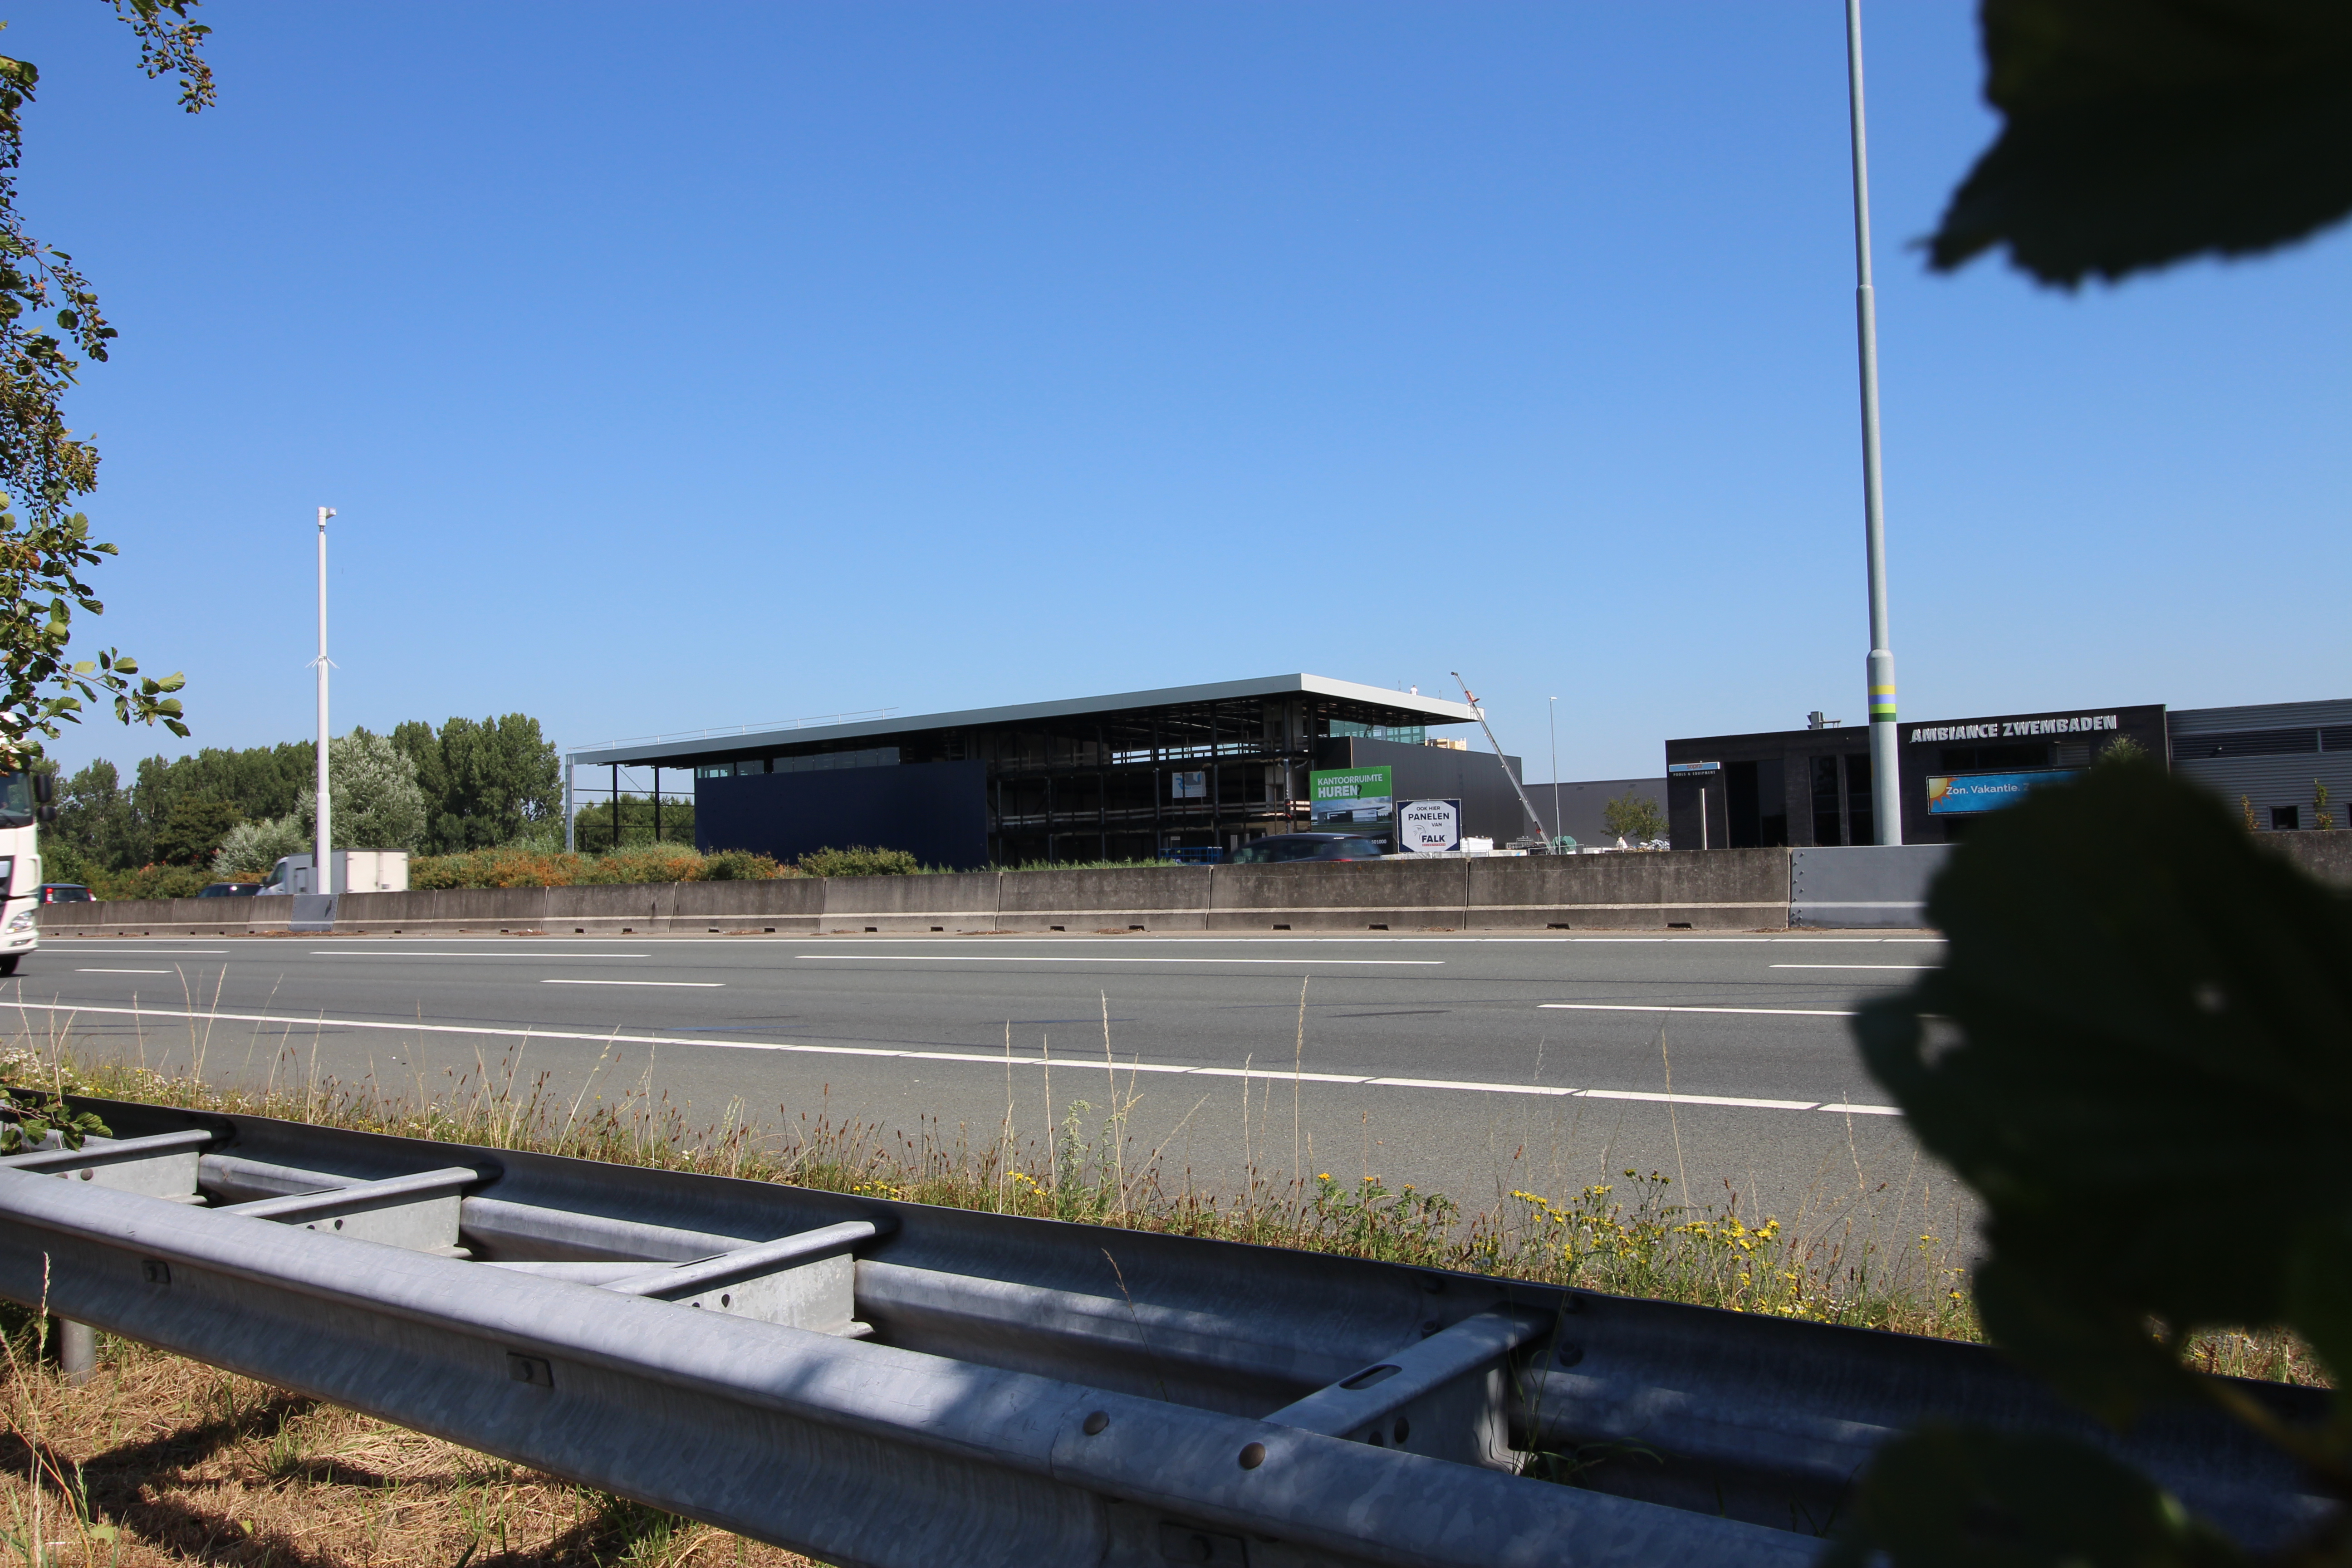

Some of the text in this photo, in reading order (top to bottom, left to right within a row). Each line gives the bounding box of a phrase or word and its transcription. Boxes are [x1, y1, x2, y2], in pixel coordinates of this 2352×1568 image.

[1911, 715, 2117, 743] AMBIANCE ZWEMBADEN
[1318, 774, 1383, 786] KANTOORRUIMTE
[1318, 784, 1362, 800] HUREN?
[1970, 784, 2020, 793] Vakantie.
[1408, 813, 1449, 821] PANELEN
